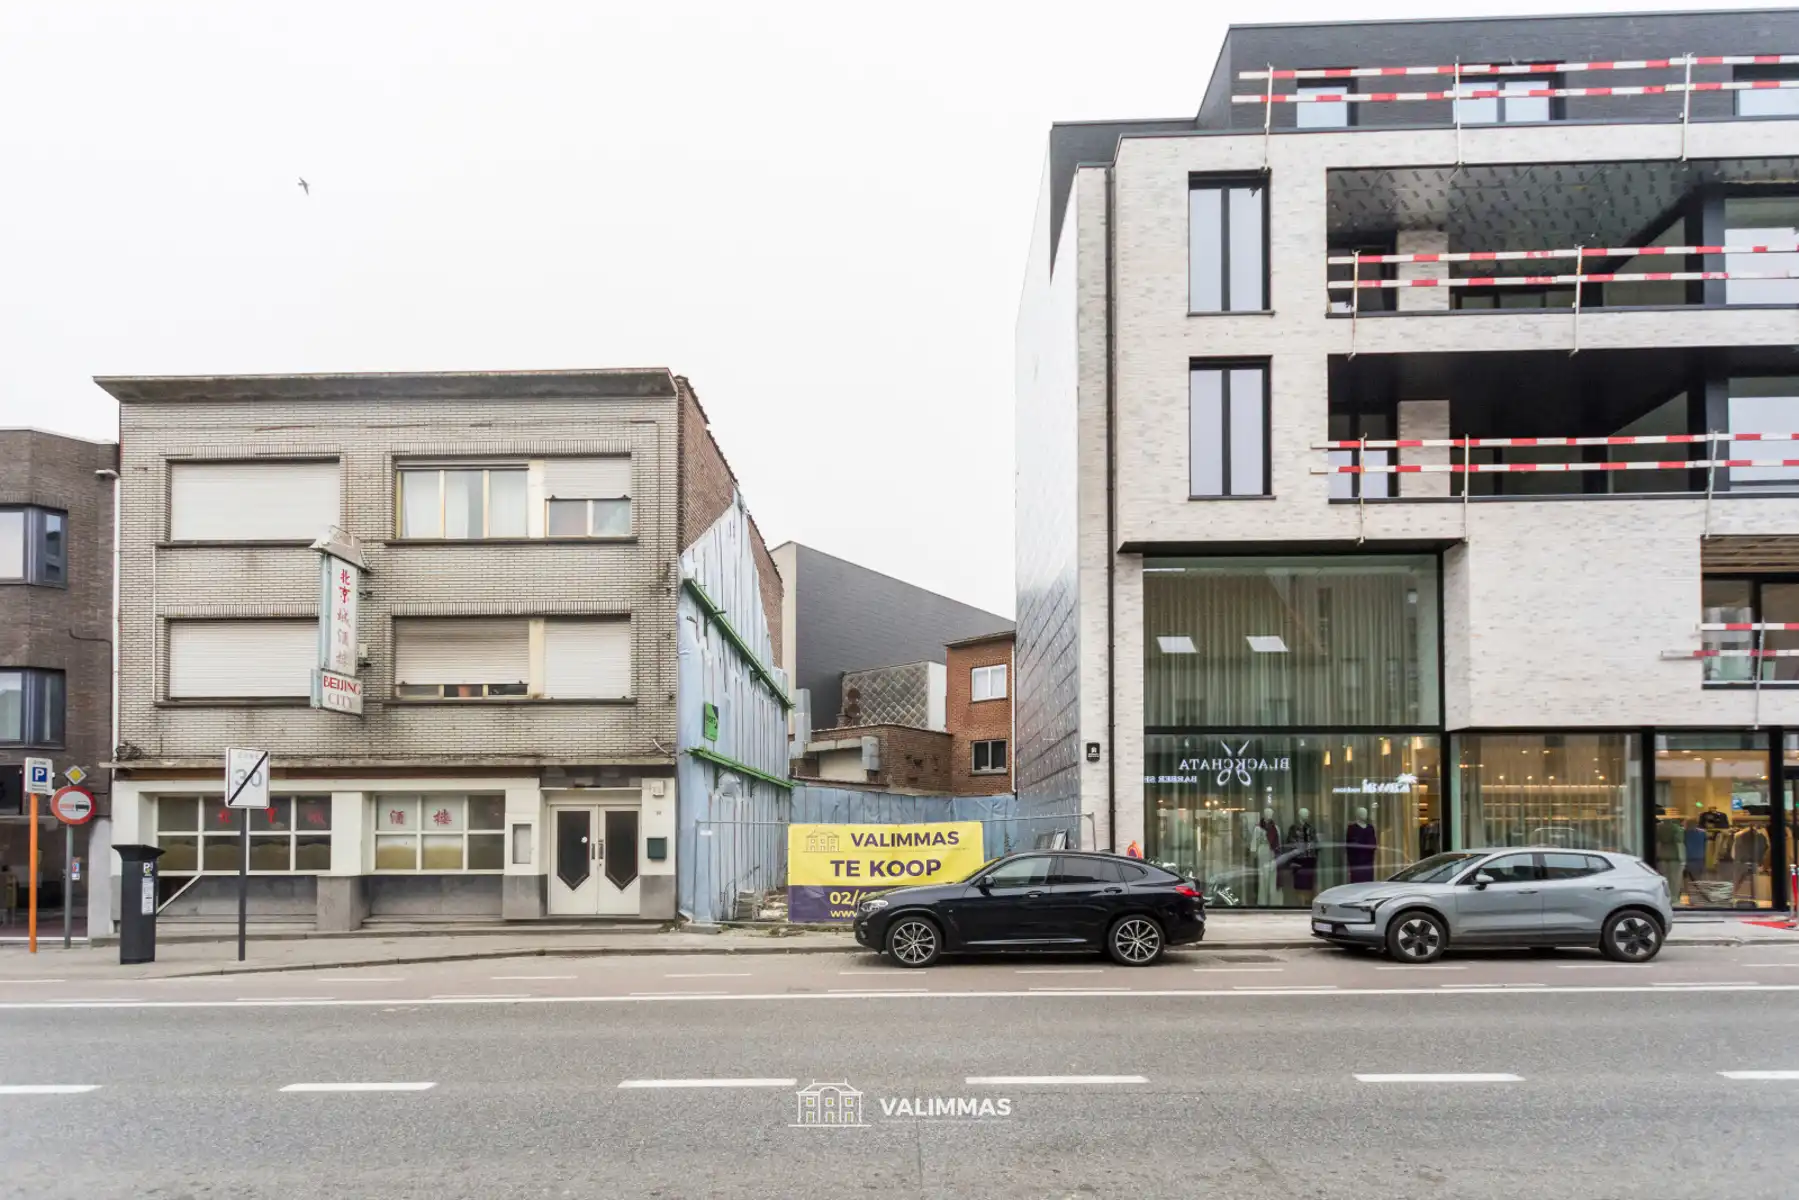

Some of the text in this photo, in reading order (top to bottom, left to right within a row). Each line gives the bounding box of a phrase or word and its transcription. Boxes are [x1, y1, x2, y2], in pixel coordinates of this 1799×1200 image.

[323, 675, 361, 695] BEIJING
[327, 692, 353, 709] CITY
[34, 768, 45, 781] P
[234, 768, 263, 788] 30
[850, 831, 960, 848] VALIMMAS
[830, 859, 942, 877] TE KOOP
